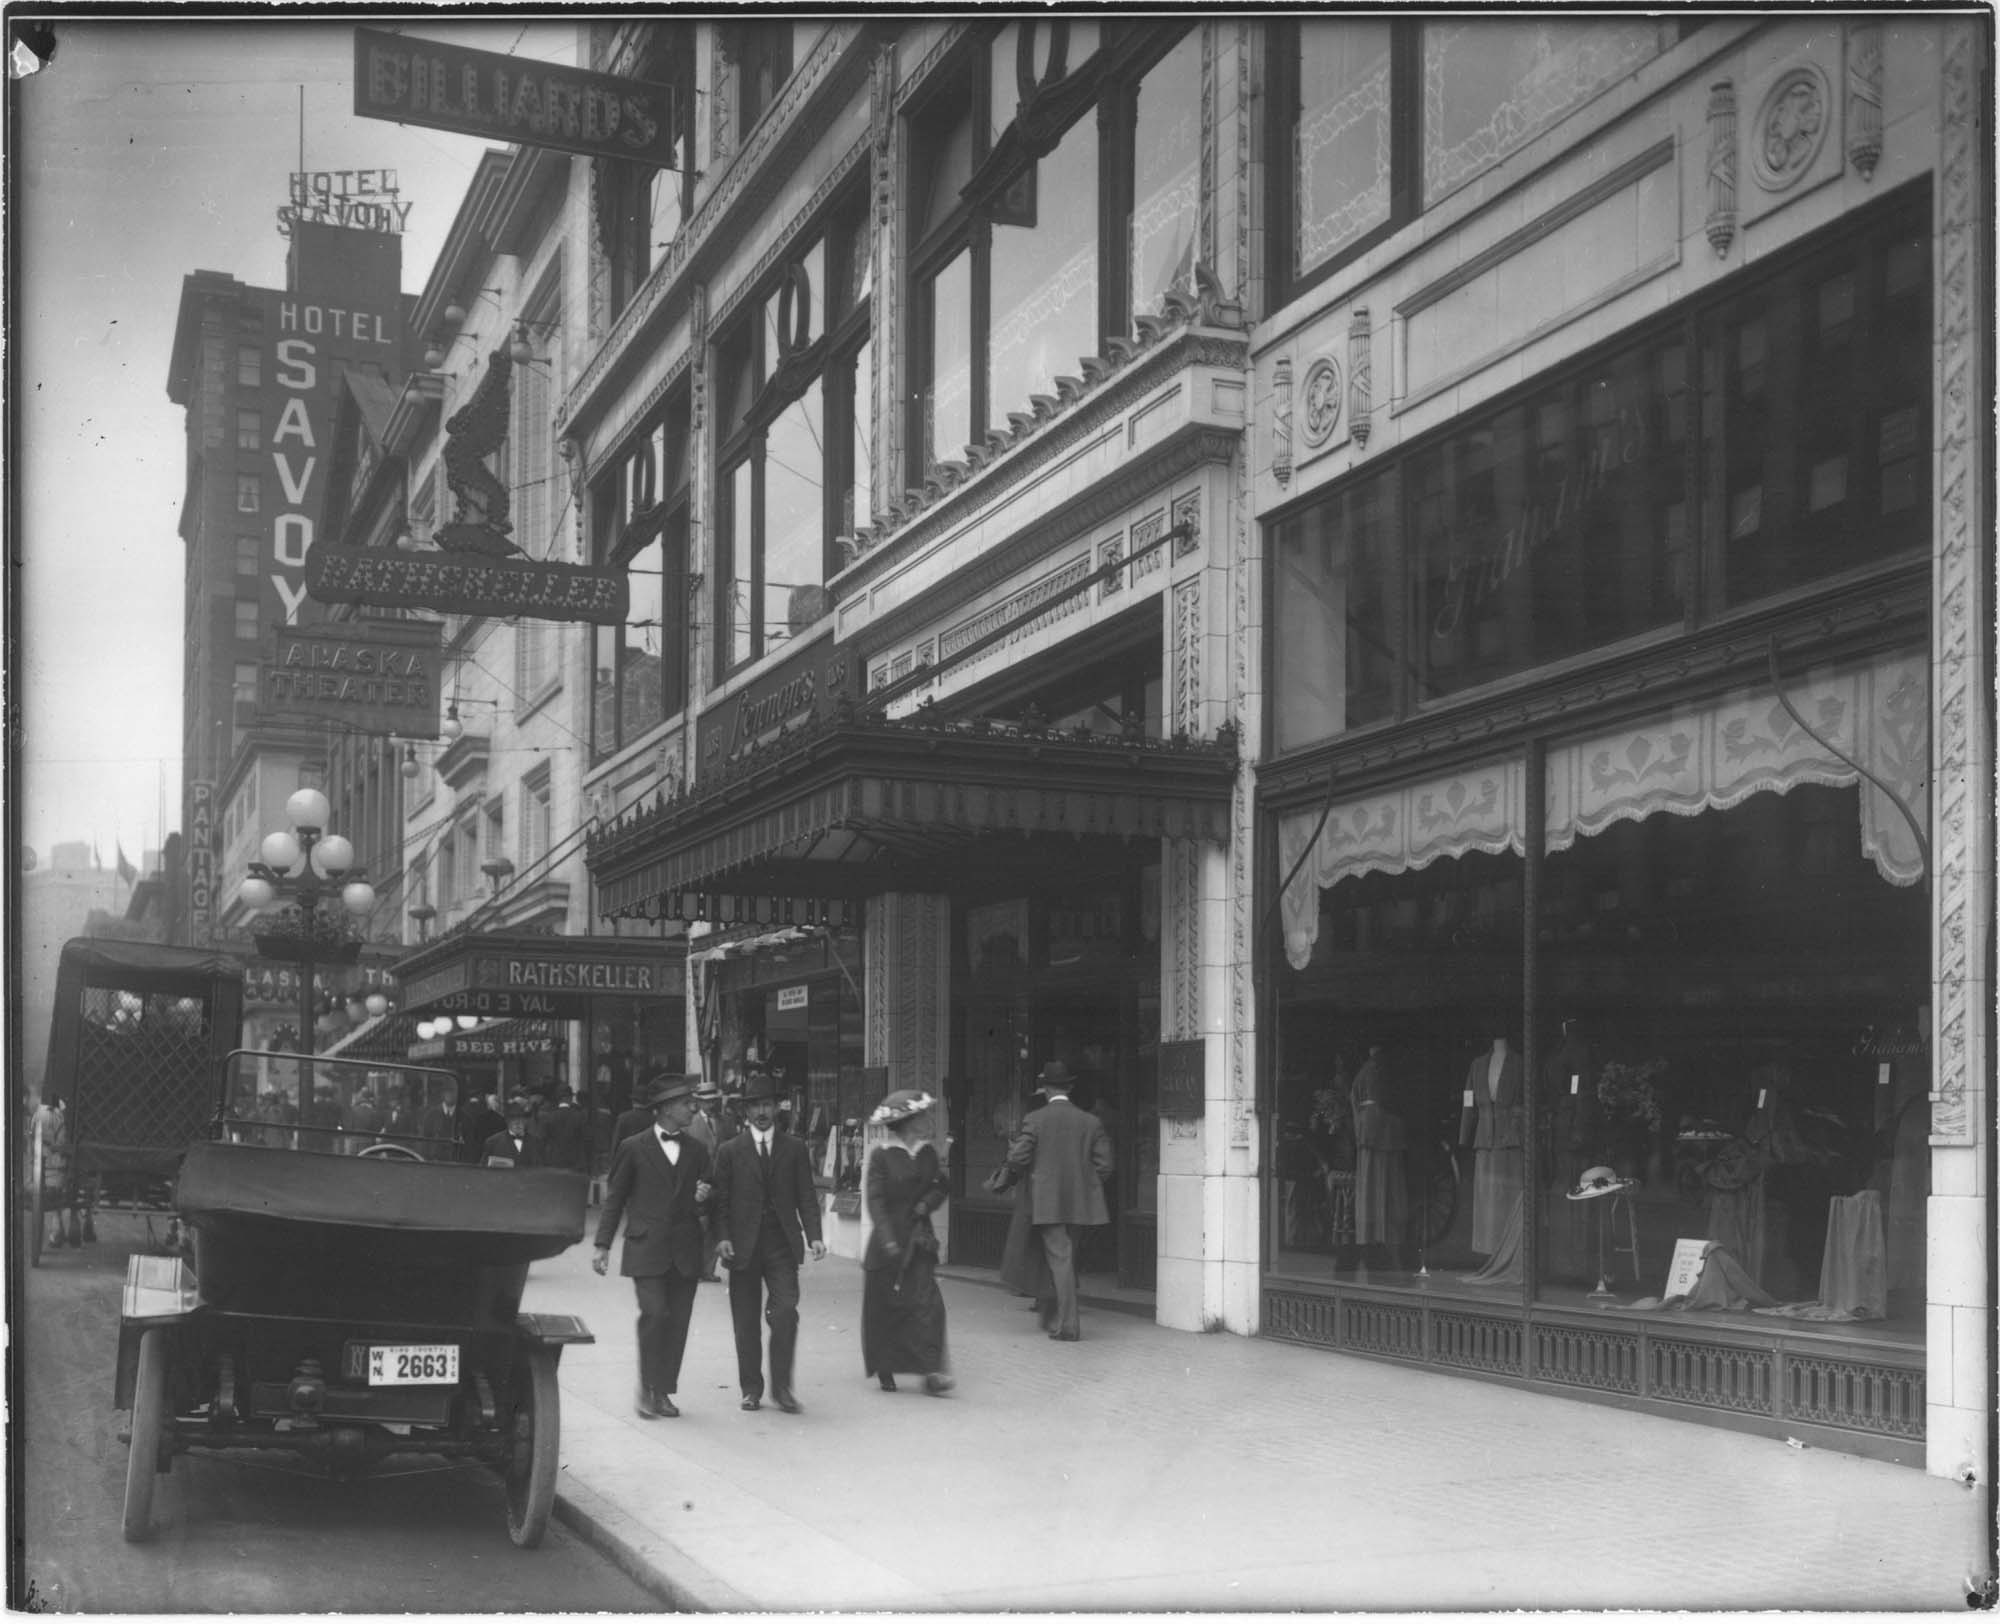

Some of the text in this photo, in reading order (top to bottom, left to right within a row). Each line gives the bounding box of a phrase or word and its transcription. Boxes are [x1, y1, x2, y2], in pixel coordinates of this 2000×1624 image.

[369, 47, 656, 148] BILLIARDS
[290, 169, 400, 196] HOTEL
[280, 301, 392, 344] HOTEL
[271, 338, 316, 626] SAVOY
[316, 553, 617, 609] RATHSKELLER
[286, 643, 427, 676] ALASKA
[271, 671, 430, 706] THEATER
[245, 968, 323, 990] LASA
[366, 968, 393, 985] TH
[509, 960, 651, 989] RATHSKELLER
[456, 1039, 495, 1054] BEE
[503, 1038, 553, 1054] HIVE
[397, 1354, 448, 1378] 2663
